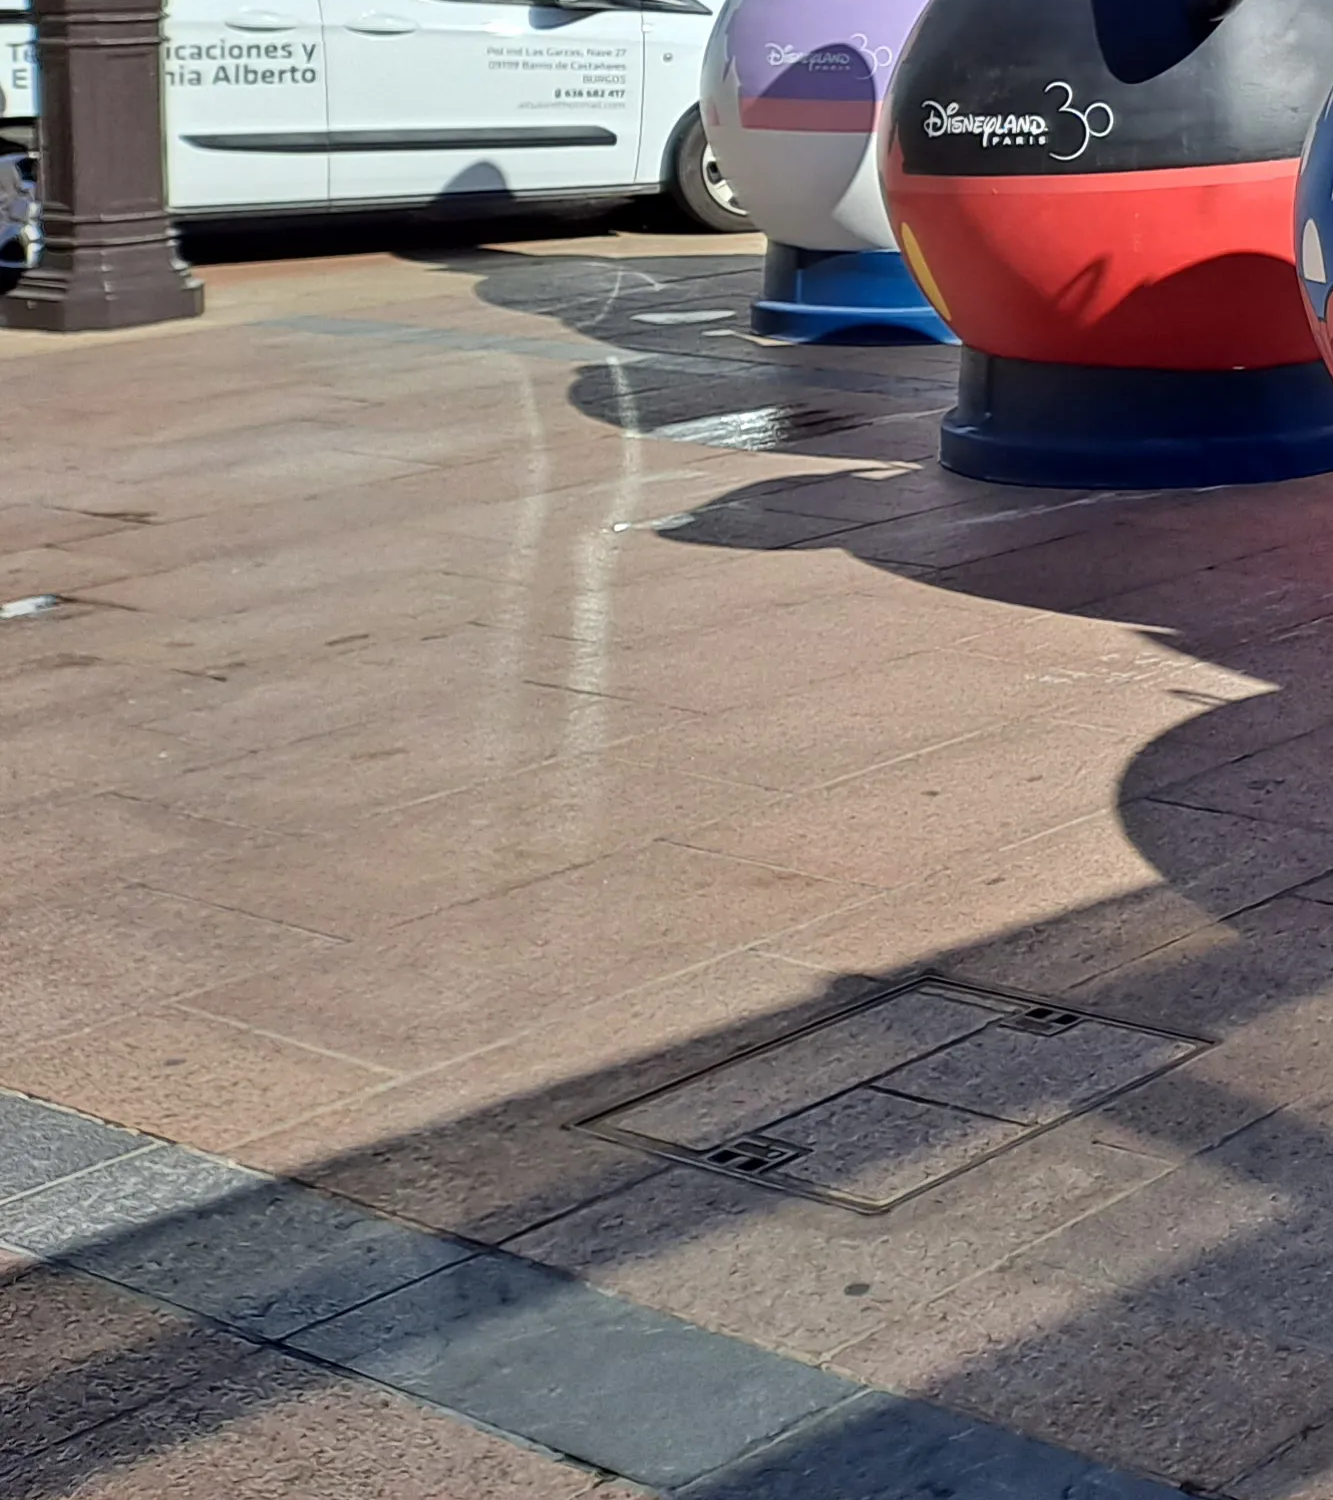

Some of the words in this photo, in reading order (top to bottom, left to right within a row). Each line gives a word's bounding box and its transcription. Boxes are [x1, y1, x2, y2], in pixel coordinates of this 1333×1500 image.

[303, 43, 316, 63] y
[212, 64, 317, 85] Alberto
[992, 136, 1047, 146] PARIS
